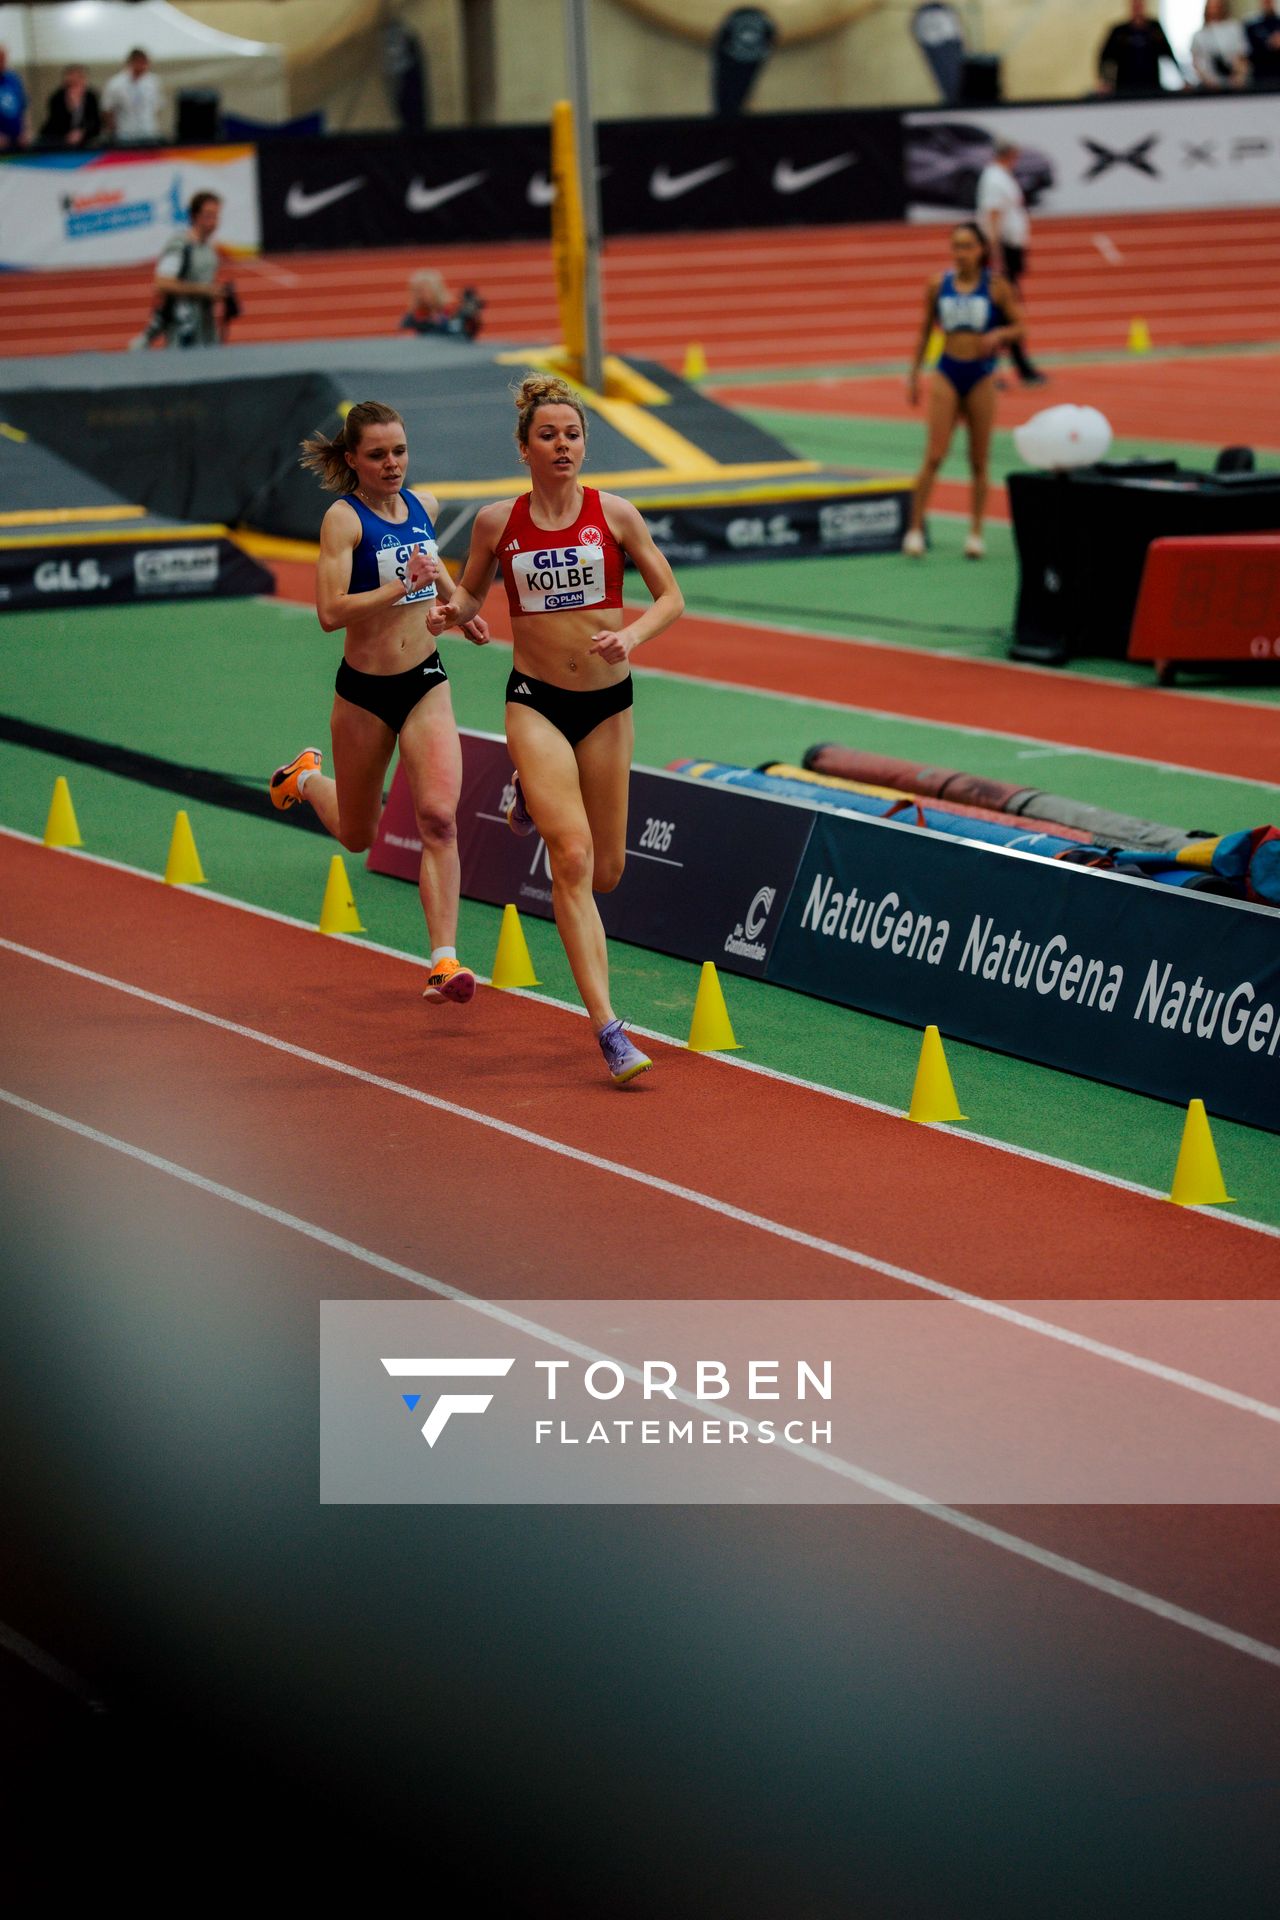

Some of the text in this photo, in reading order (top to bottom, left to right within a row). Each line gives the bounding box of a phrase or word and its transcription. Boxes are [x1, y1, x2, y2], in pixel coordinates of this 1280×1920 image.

[526, 566, 595, 592] KOLBE
[560, 593, 583, 603] PLAN
[639, 818, 675, 852] 2026
[800, 873, 950, 965] NatuGena
[958, 914, 1124, 1013] NatuGena
